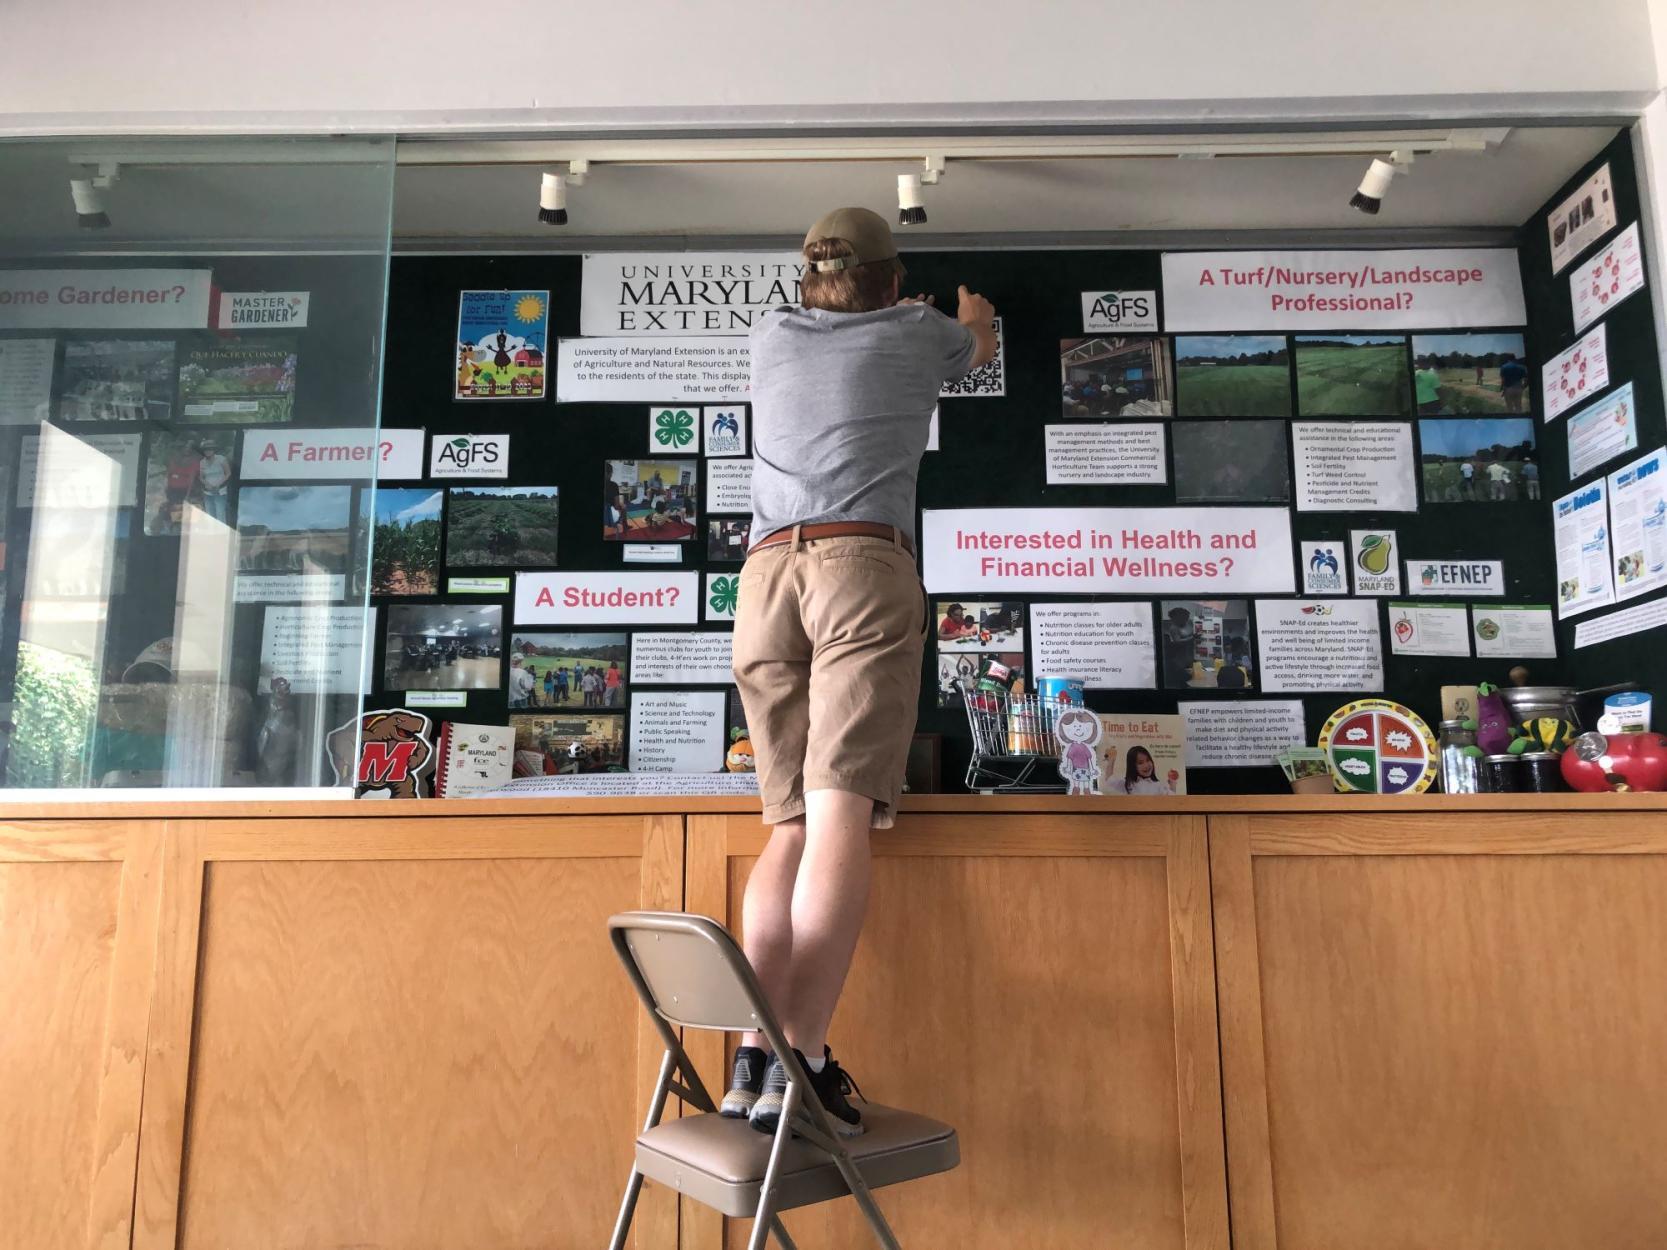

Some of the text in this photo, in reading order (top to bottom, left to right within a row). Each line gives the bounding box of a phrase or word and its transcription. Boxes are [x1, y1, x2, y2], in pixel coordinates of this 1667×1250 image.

[621, 265, 805, 279] UNIVERSITY
[1200, 265, 1483, 288] A Turf/Nursery/Landscape
[58, 286, 185, 304] Gardener?
[618, 280, 801, 305] MARYLA
[233, 298, 285, 308] MASTER
[1090, 298, 1148, 322] AgFS
[1272, 293, 1414, 312] Professional?
[231, 308, 289, 323] GARDENER
[617, 310, 770, 330] EXTEN
[574, 348, 618, 358] University
[620, 346, 629, 356] of
[630, 346, 672, 357] Maryland
[674, 346, 716, 356] Extension
[718, 346, 725, 356] is
[572, 360, 582, 369] of
[584, 360, 633, 370] Agriculture
[634, 360, 651, 368] and
[652, 360, 686, 368] Natural
[736, 360, 751, 368] We
[588, 372, 604, 380] the
[605, 372, 646, 380] residents
[647, 372, 657, 380] of
[659, 372, 674, 380] the
[702, 372, 720, 380] This
[721, 372, 751, 382] display
[683, 384, 701, 392] that
[718, 384, 742, 392] offer.
[260, 441, 393, 462] A Farmer?
[438, 442, 498, 468] AgFS
[957, 530, 1256, 549] Interested in Health and
[981, 557, 1234, 576] Financial Wellness?
[1441, 564, 1492, 584] EFNEP
[1359, 582, 1395, 591] SNAP-ED
[536, 587, 680, 608] A Student?
[660, 638, 698, 646] Montgomery
[1103, 721, 1159, 732] Time to Eat
[359, 742, 418, 782] M
